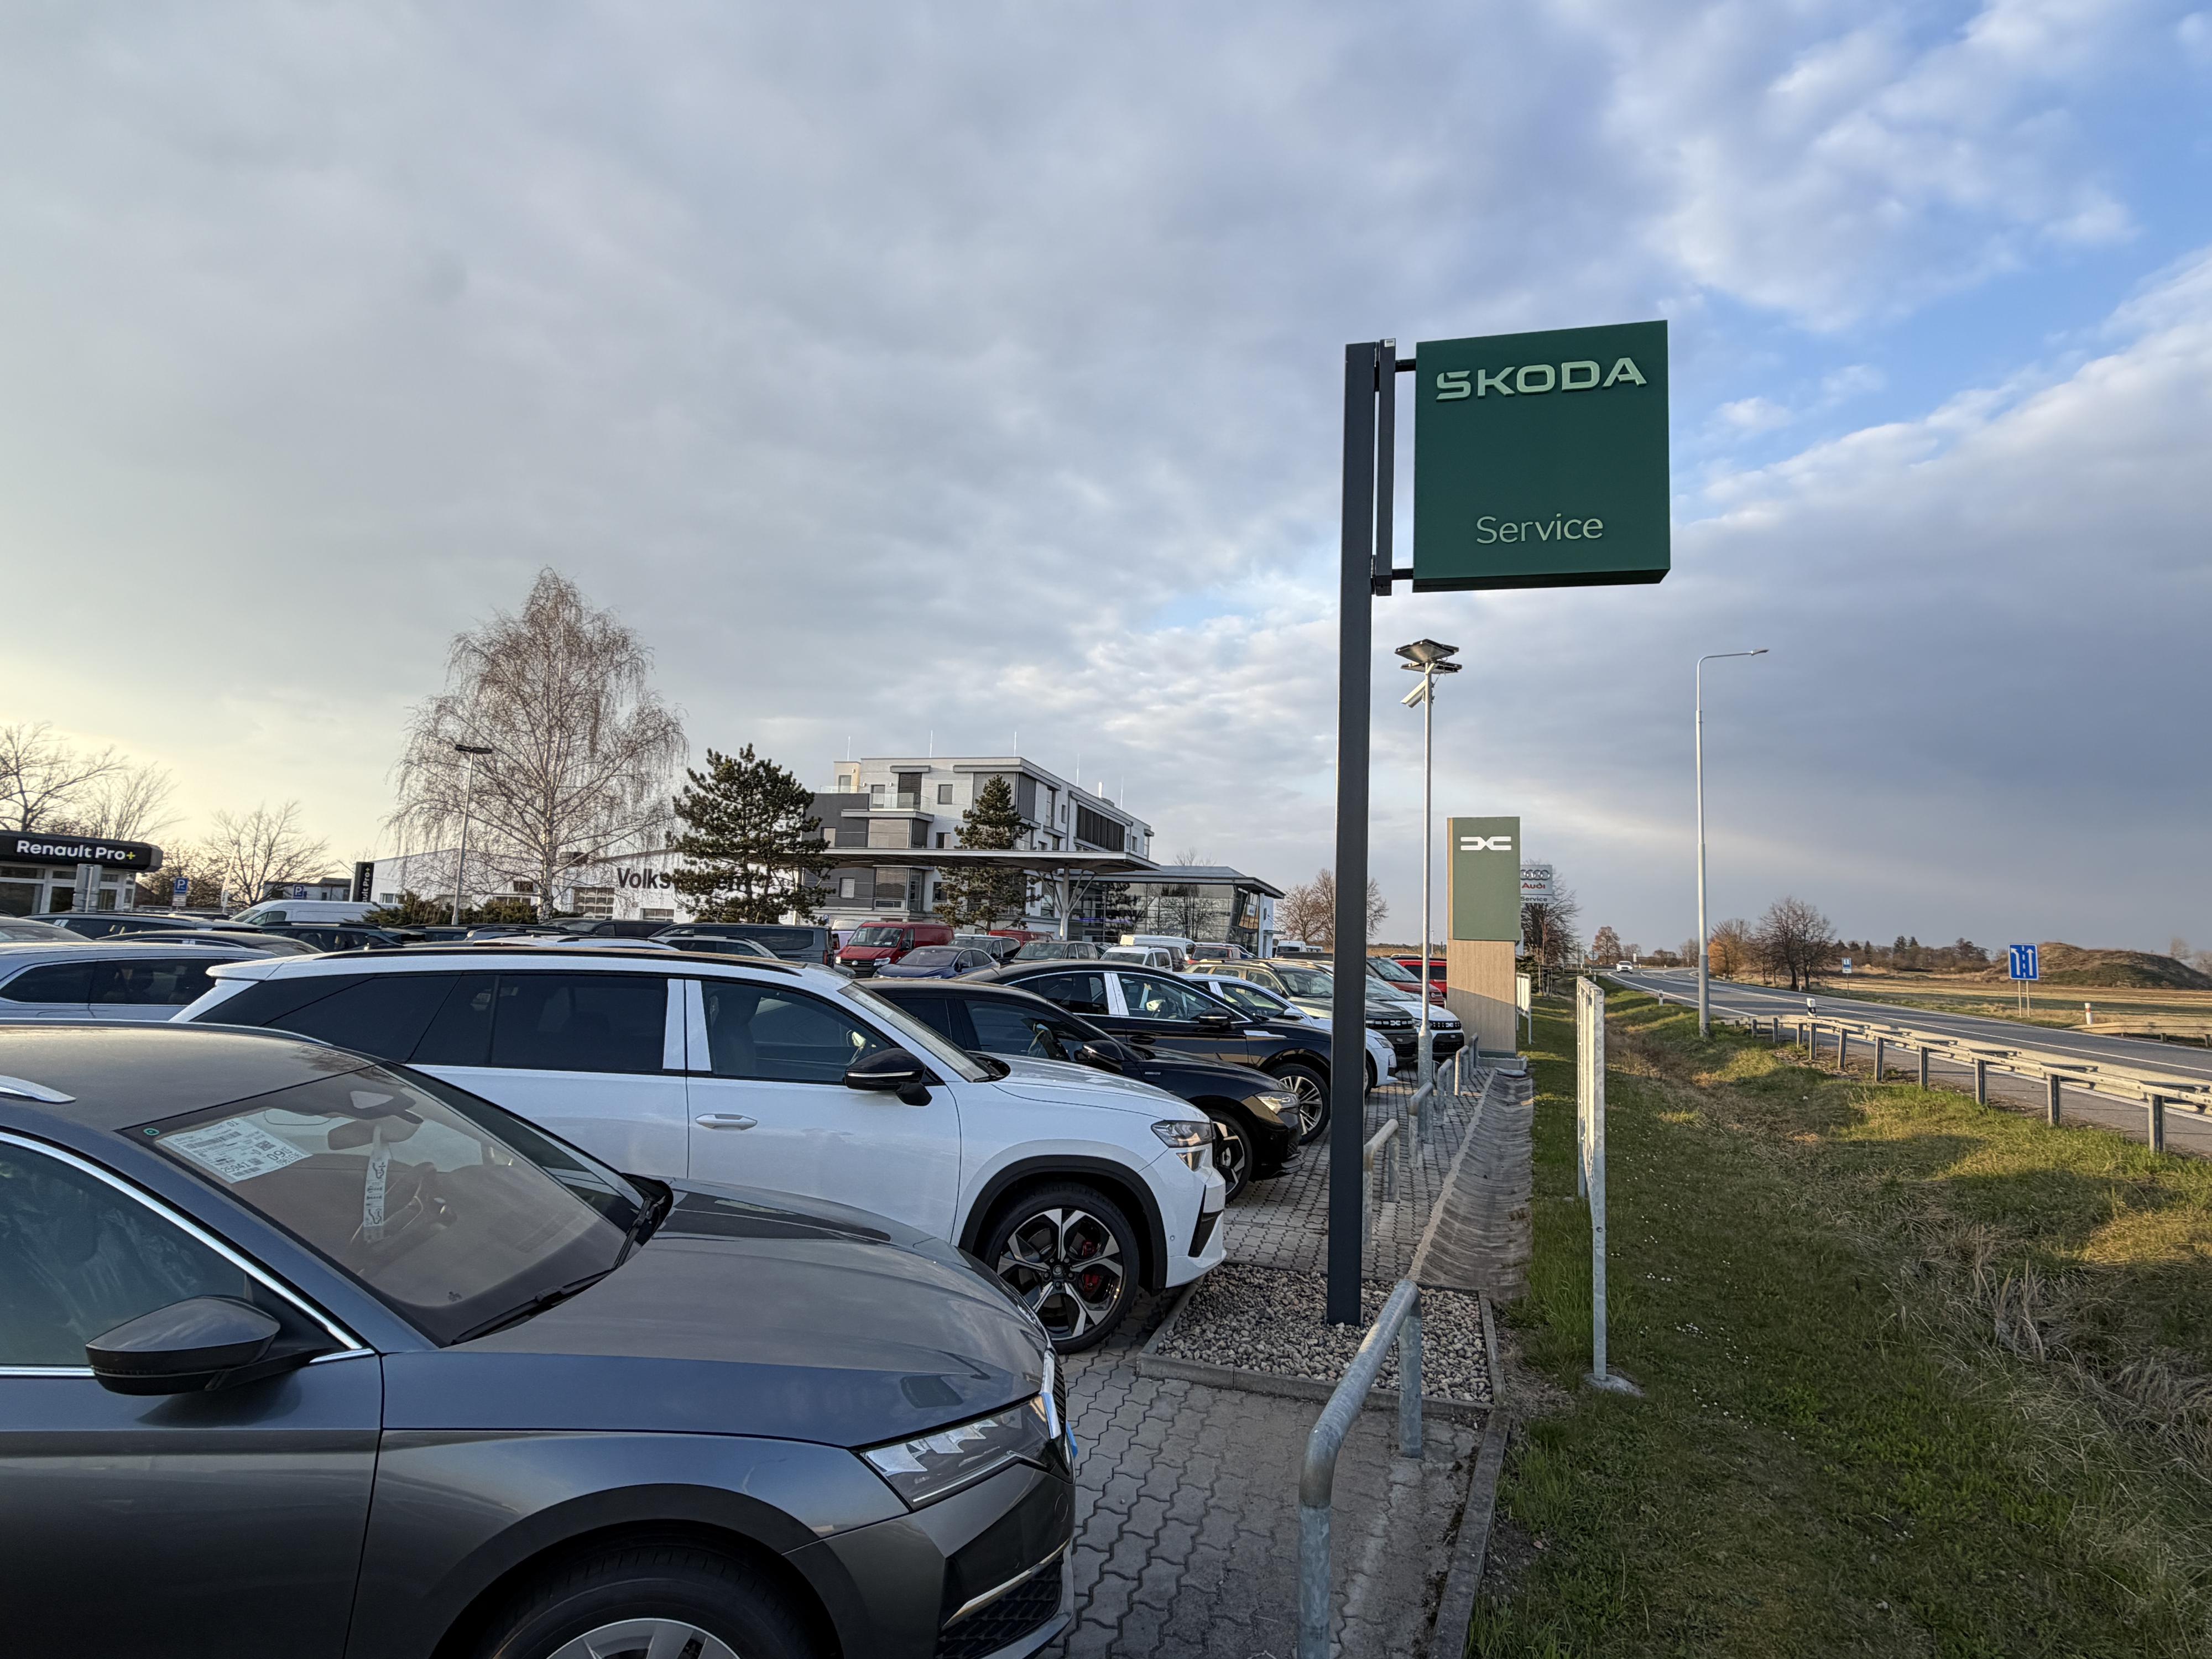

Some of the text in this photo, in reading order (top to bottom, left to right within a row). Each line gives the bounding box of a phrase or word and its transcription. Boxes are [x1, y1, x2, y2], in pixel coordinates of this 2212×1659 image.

[1476, 513, 1604, 544] Service
[16, 839, 136, 861] Renault Pro+
[177, 879, 185, 889] P
